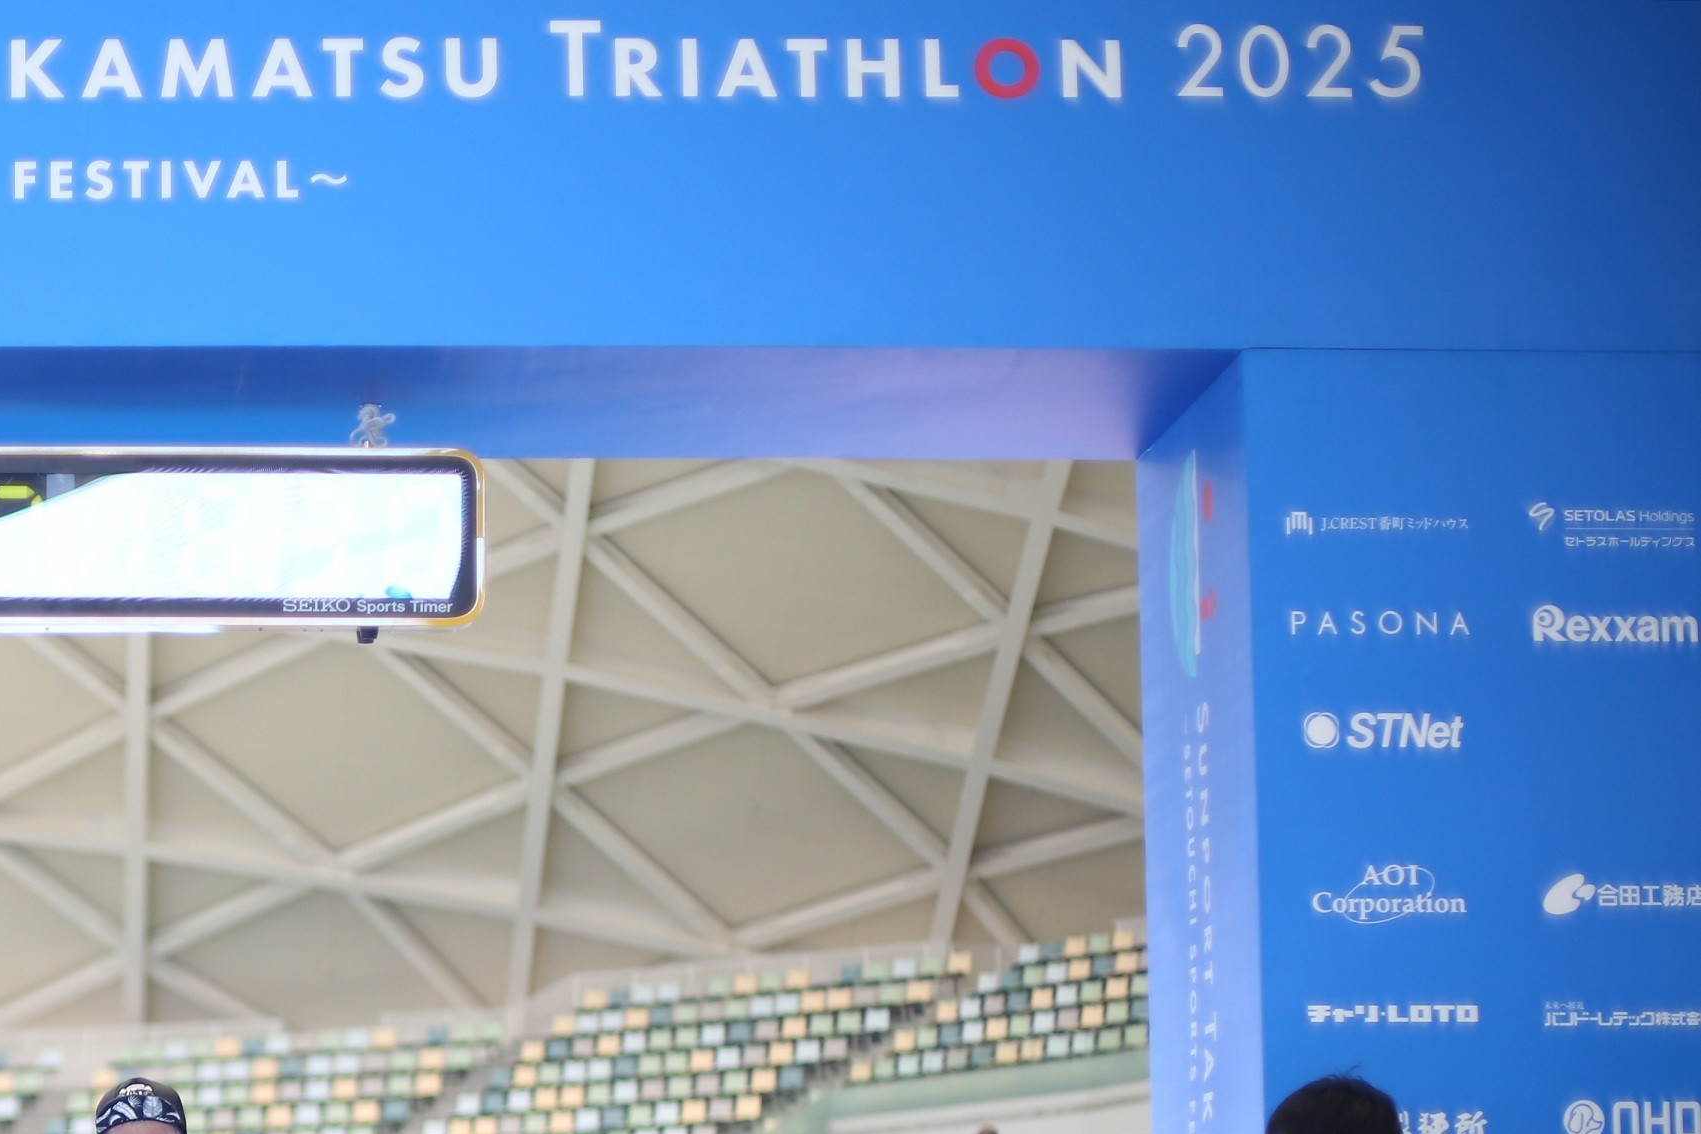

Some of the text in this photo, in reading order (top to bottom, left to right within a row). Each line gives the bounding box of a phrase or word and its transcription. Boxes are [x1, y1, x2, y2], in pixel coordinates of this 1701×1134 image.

[550, 19, 1124, 101] TRIATHLON
[1176, 23, 1426, 99] 2025
[1564, 509, 1695, 526] SETOLAS Holdings
[282, 598, 453, 615] SEIKO Sports Timer
[1290, 609, 1471, 637] PASONA
[1532, 604, 1699, 643] Rexxam
[1346, 712, 1465, 749] STNet
[1197, 701, 1214, 985] SUNPORT
[1362, 864, 1419, 887] AOI
[1312, 891, 1468, 921] Corporation
[1597, 884, 1701, 908] 合田工務店
